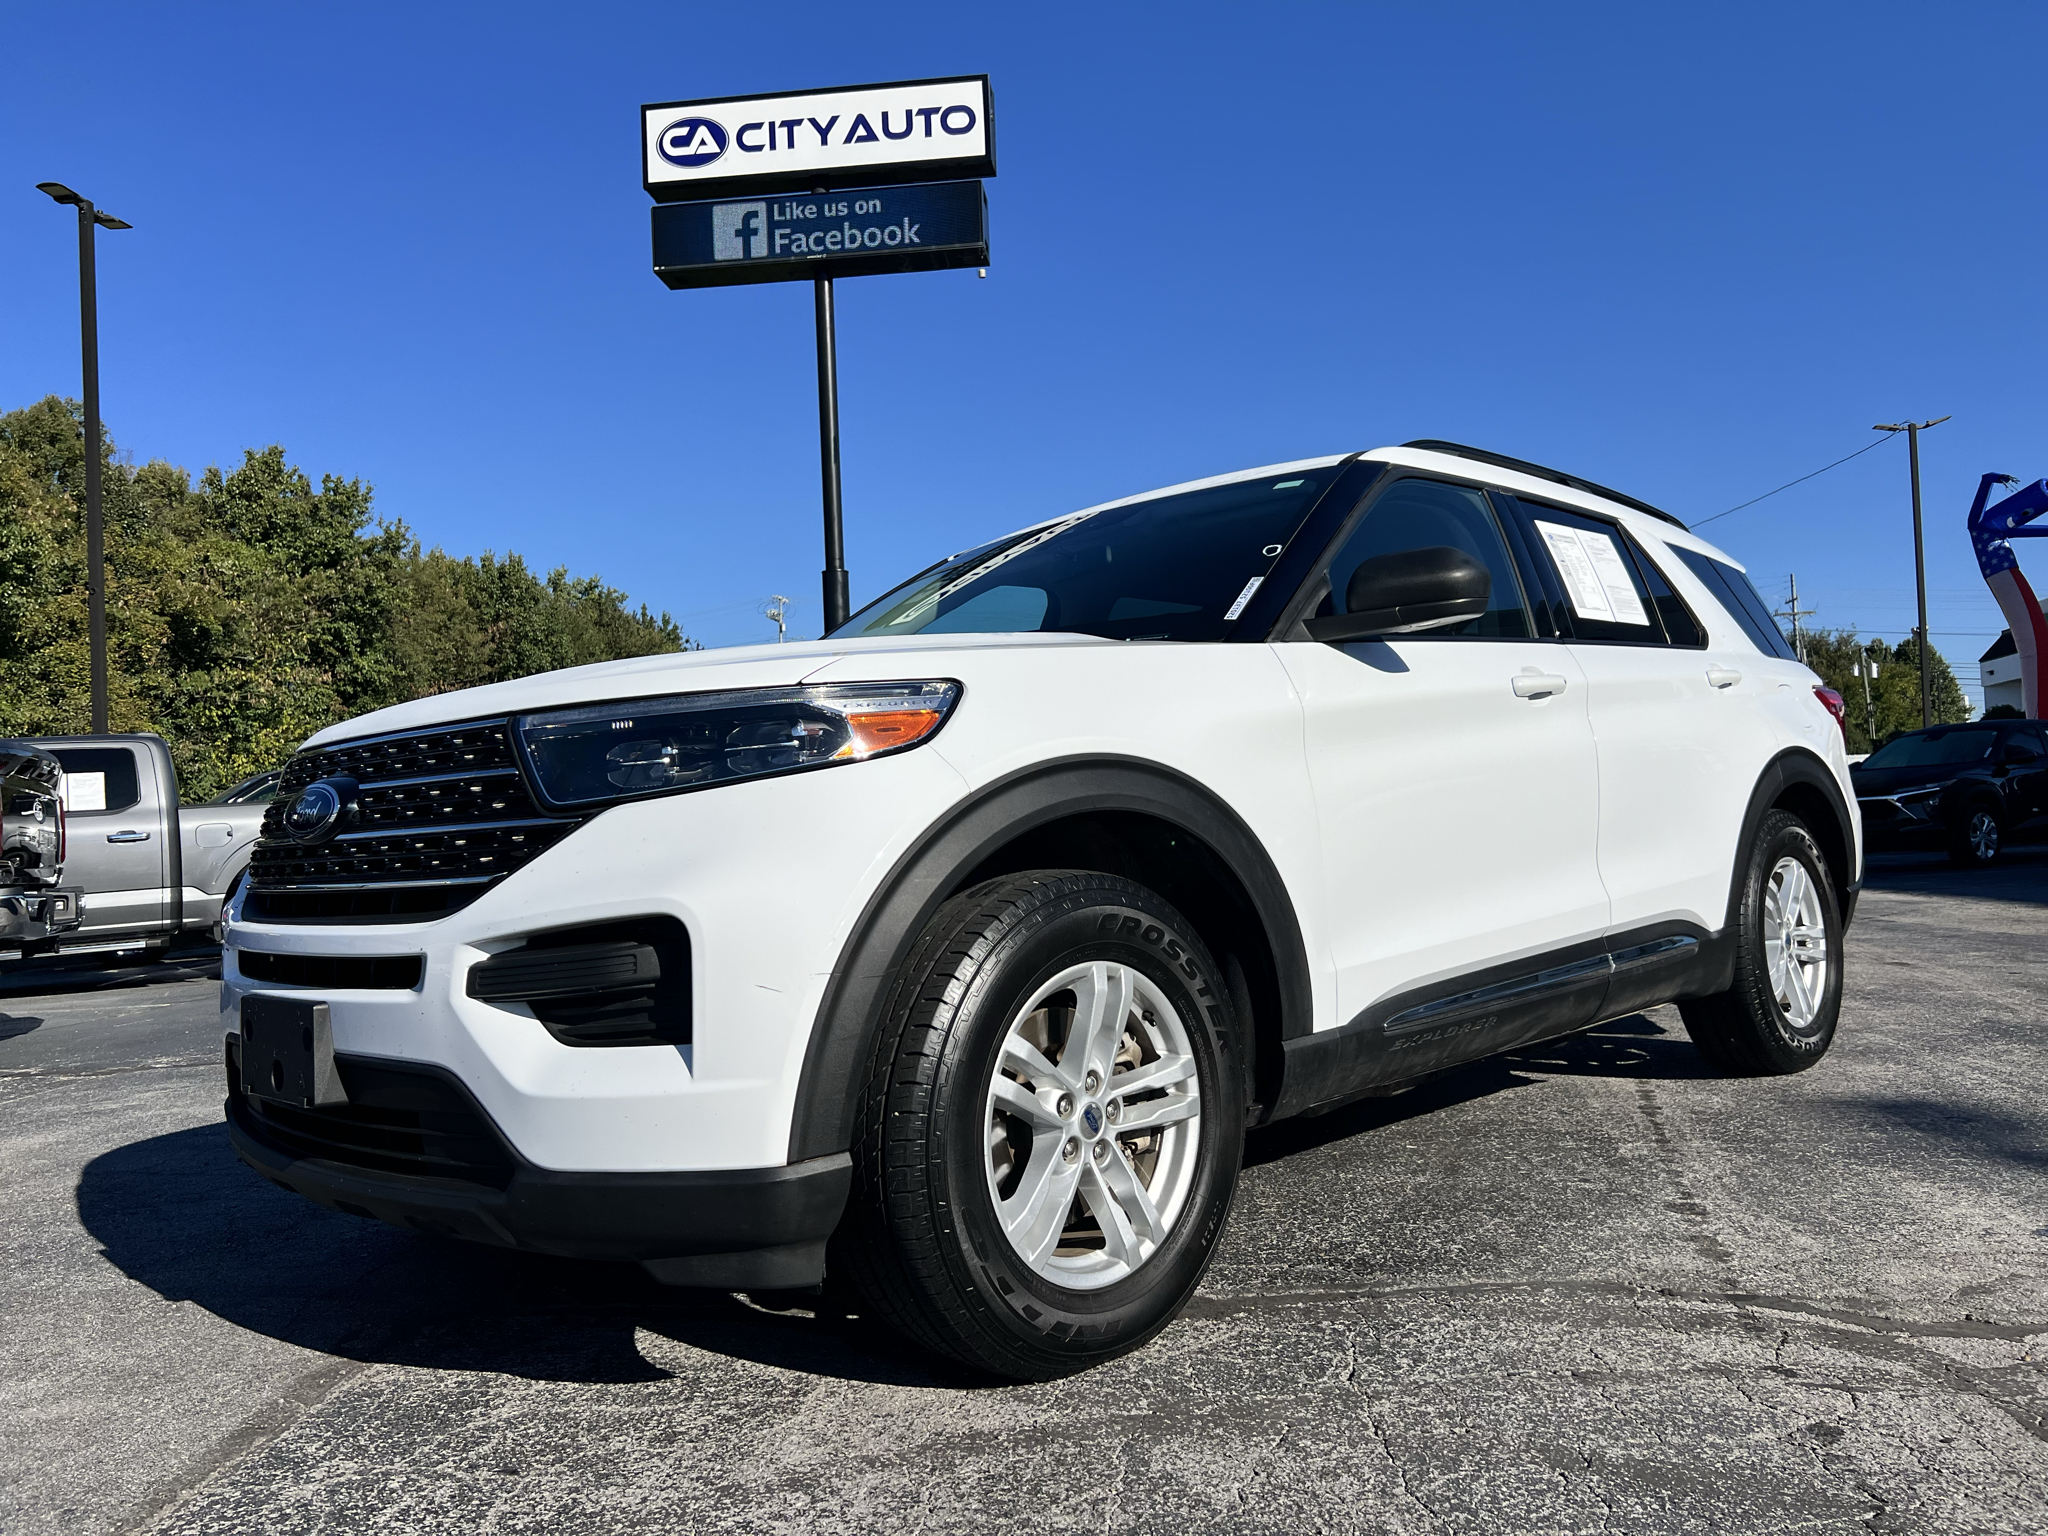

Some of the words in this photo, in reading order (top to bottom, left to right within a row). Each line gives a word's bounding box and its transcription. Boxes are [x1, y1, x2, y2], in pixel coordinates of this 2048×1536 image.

[773, 201, 817, 221] Like
[824, 203, 848, 217] us
[855, 199, 881, 214] on
[774, 217, 921, 254] Facebook
[290, 795, 322, 824] Ford
[1097, 913, 1234, 1057] CROSSTEK
[1389, 1016, 1498, 1051] EXPLORER
